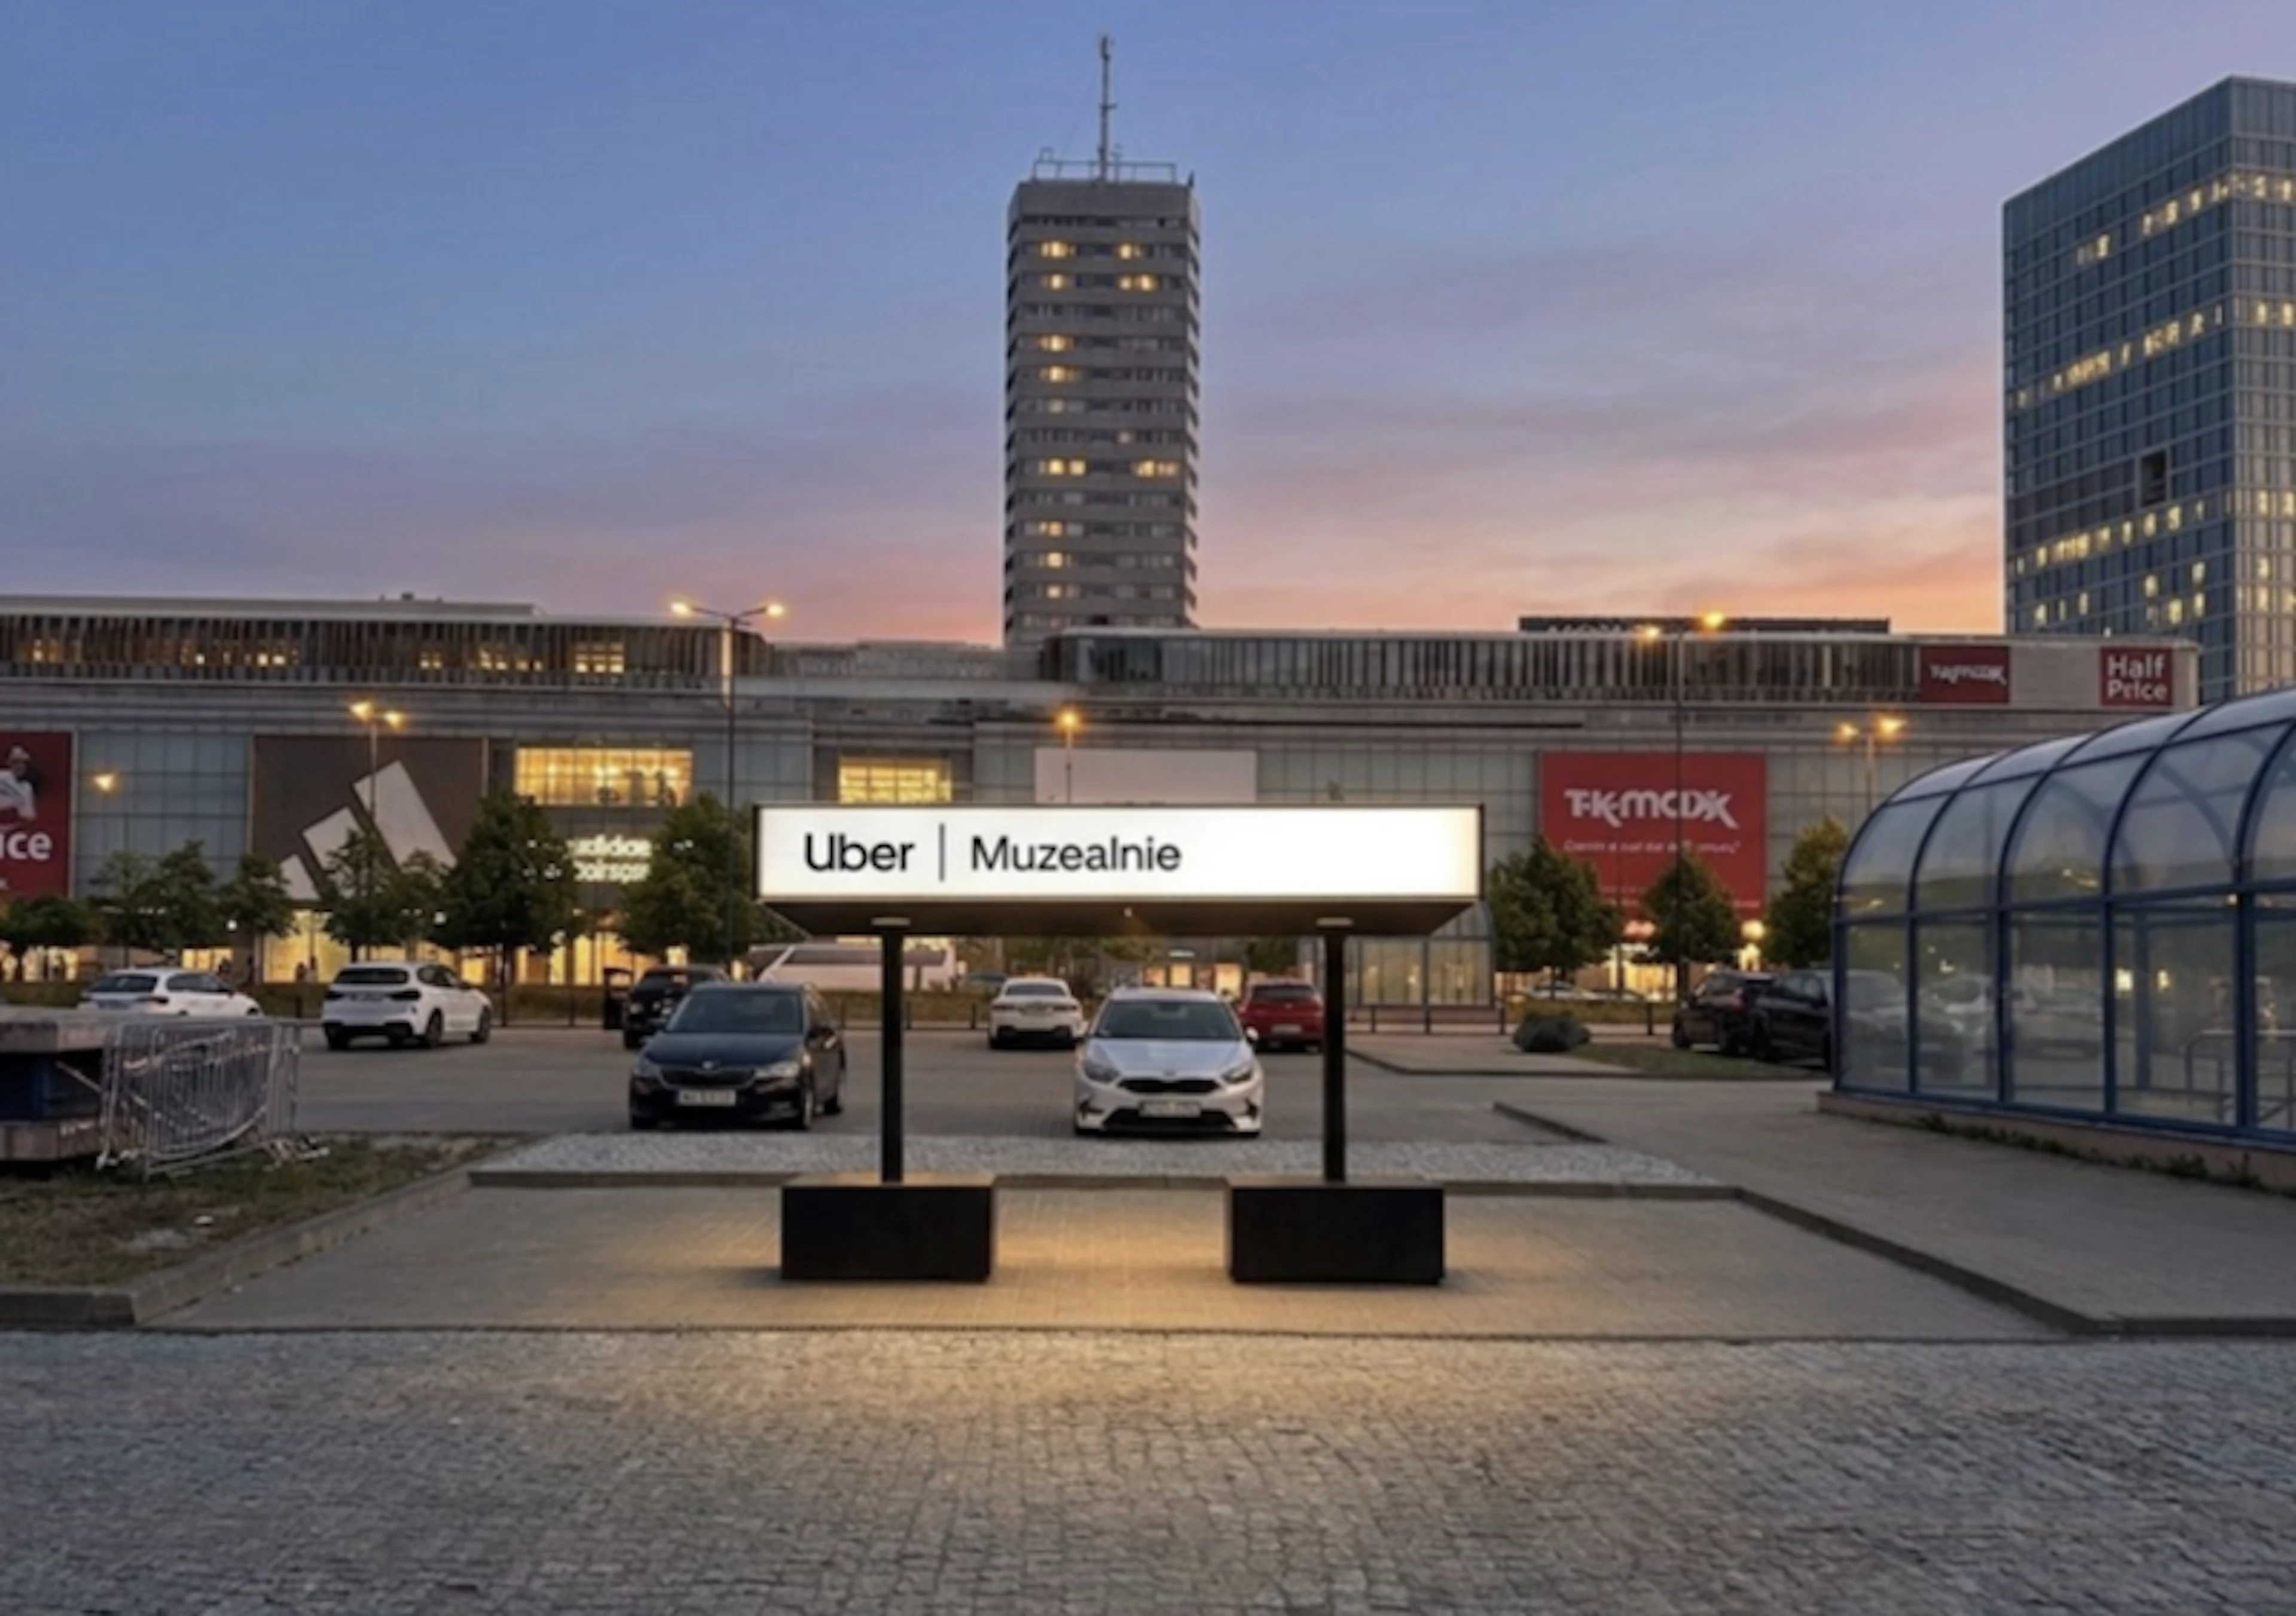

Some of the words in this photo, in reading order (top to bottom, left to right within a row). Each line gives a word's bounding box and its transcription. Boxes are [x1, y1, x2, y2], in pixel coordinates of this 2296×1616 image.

[2108, 653, 2165, 678] Half
[2108, 679, 2168, 701] Price
[804, 832, 915, 872] Uber
[971, 835, 1181, 873] Muzealnie
